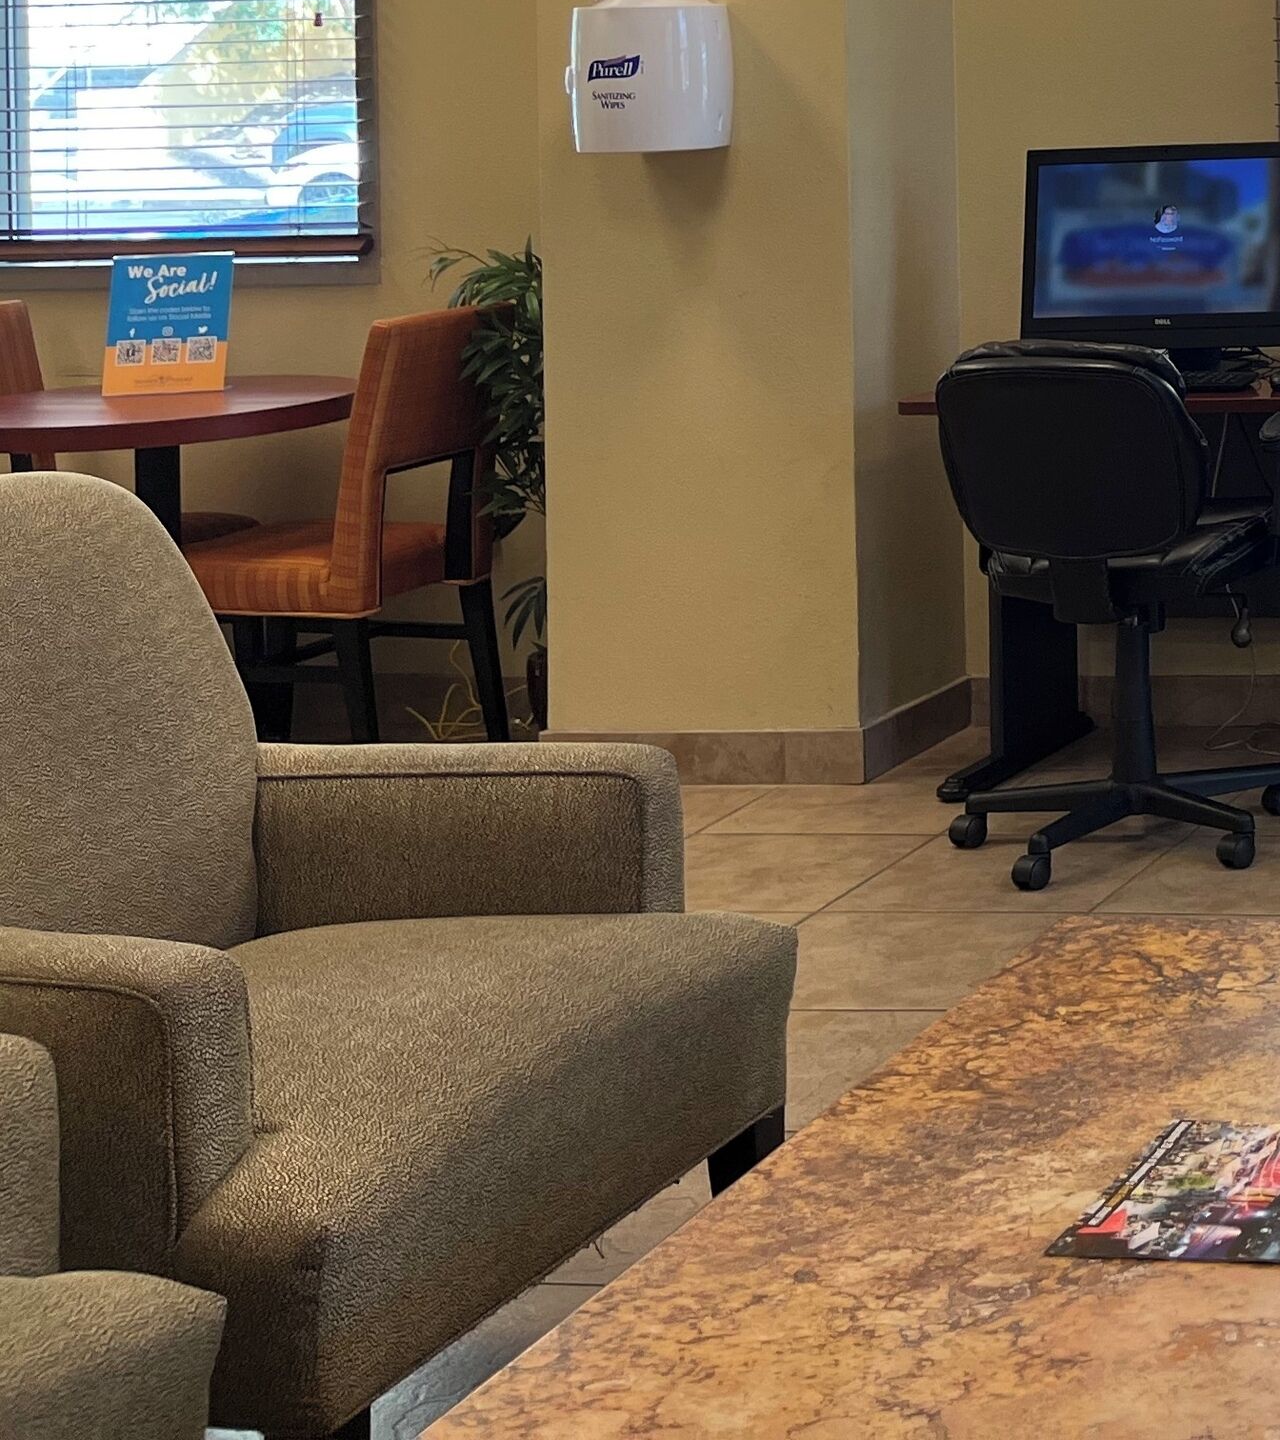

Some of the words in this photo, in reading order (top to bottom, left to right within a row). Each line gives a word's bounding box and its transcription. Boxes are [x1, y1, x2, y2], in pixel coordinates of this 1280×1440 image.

[592, 61, 633, 78] Purell
[592, 90, 636, 101] SANITIZING
[601, 100, 625, 109] WIPES
[128, 266, 153, 279] We
[158, 264, 187, 277] Are
[144, 271, 218, 304] Social!
